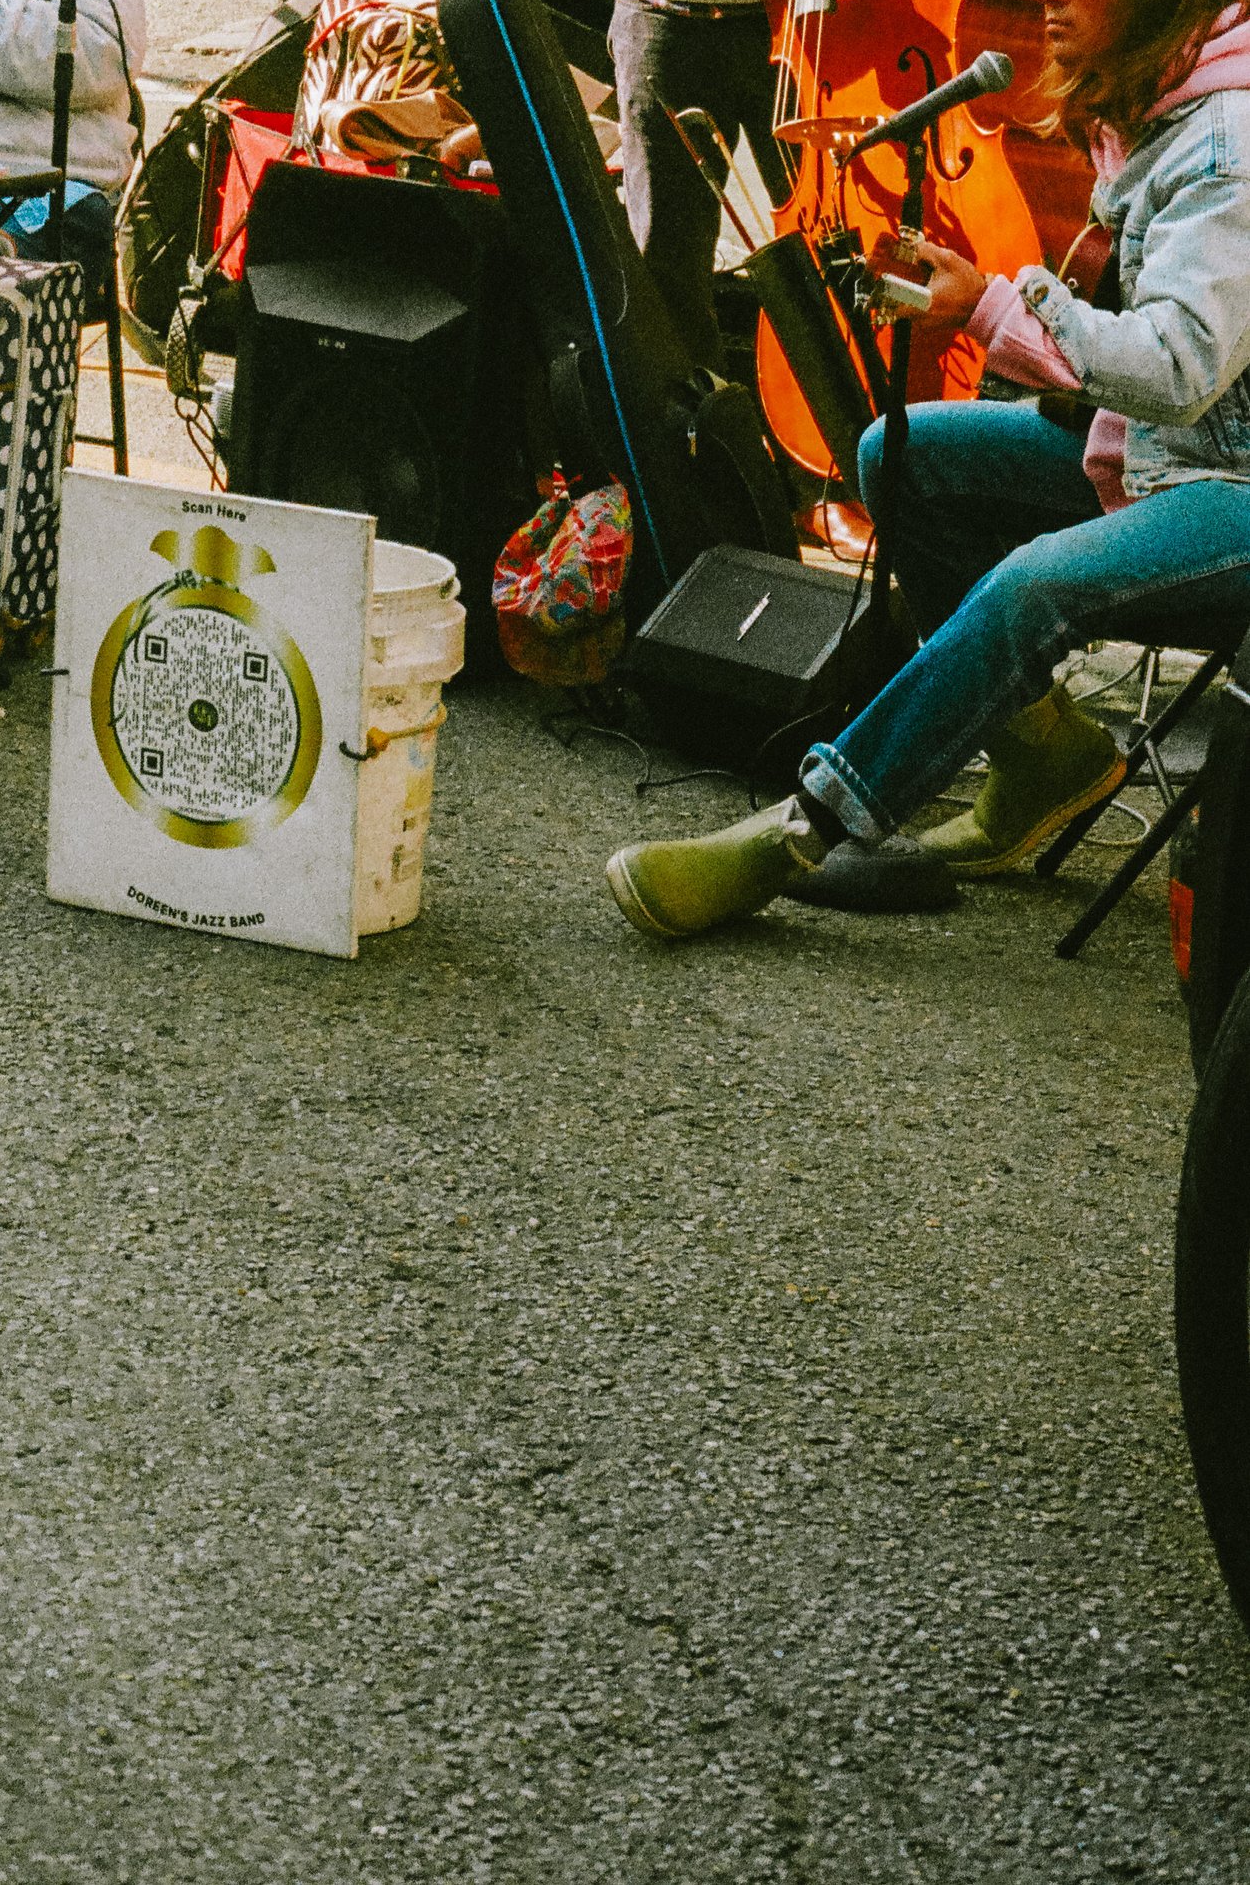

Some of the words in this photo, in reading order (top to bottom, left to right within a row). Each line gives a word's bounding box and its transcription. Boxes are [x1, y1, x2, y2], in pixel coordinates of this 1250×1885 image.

[181, 500, 213, 514] Scan
[216, 504, 246, 523] Here
[127, 885, 189, 923] DOREEN'S
[192, 914, 226, 928] JAZZ
[229, 912, 266, 928] BAND
